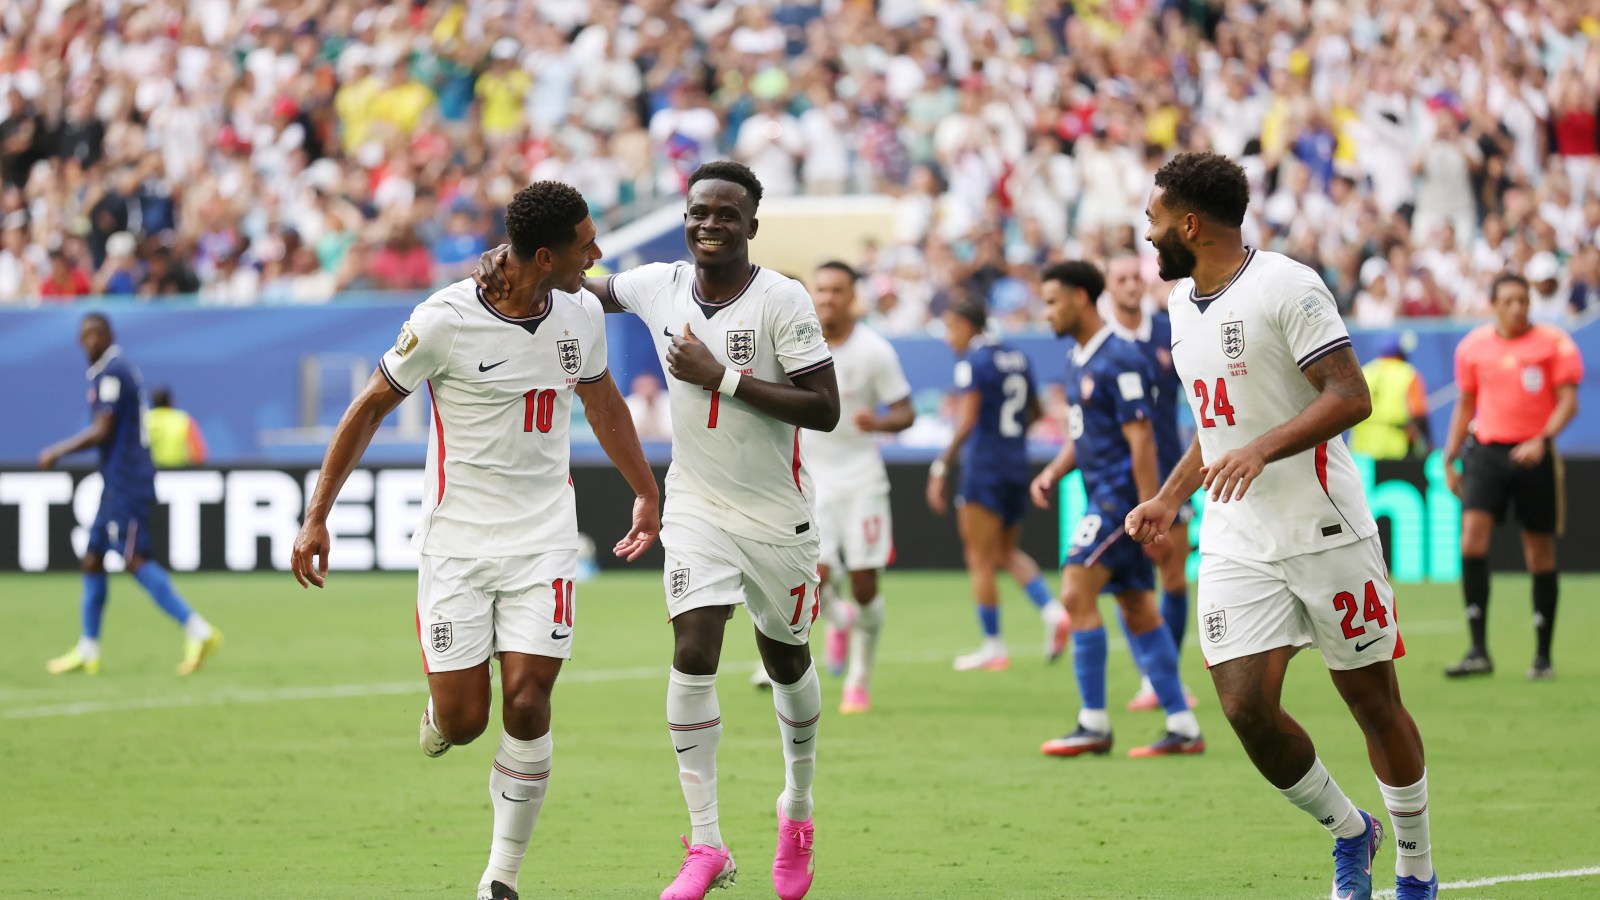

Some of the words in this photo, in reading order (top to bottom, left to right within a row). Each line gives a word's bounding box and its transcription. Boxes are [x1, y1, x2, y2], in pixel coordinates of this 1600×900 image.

[1227, 362, 1247, 370] FRANCE
[523, 388, 557, 433] 10
[999, 375, 1029, 438] 2
[1193, 377, 1236, 428] 24
[551, 578, 573, 627] 10
[790, 582, 806, 626] 7
[1333, 579, 1388, 640] 24
[1398, 839, 1417, 850] ENG
